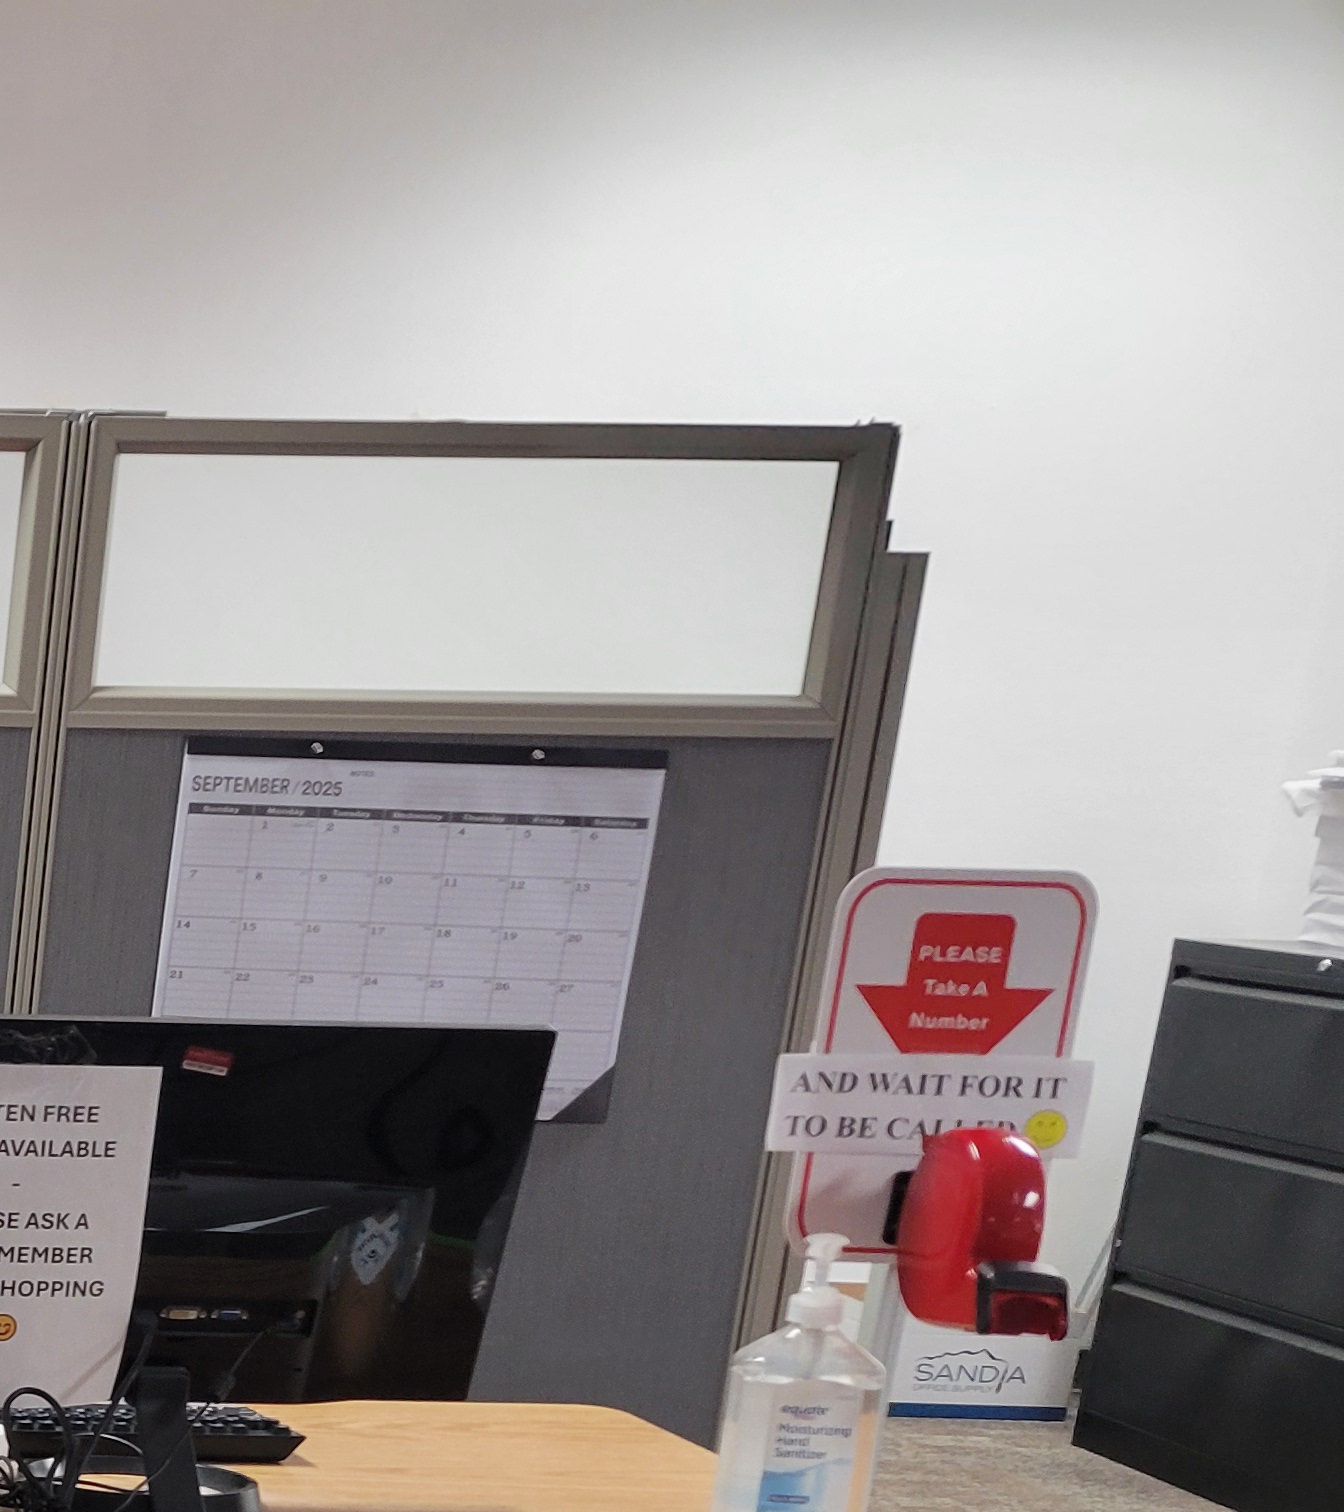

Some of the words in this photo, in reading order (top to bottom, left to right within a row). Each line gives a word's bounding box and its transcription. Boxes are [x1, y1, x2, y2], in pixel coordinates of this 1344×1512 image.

[192, 776, 291, 794] SEPTEMBER
[302, 781, 343, 796] 2025
[324, 823, 334, 832] 2
[378, 876, 393, 885] 10
[444, 879, 457, 887] 11
[511, 881, 525, 890] 12
[176, 920, 190, 929] 14
[242, 923, 256, 931] 15
[307, 925, 320, 933] 16
[371, 927, 385, 936] 17
[436, 929, 451, 938] 18
[503, 932, 517, 940] 19
[567, 934, 582, 943] 20
[919, 946, 1003, 964] PLEASE
[170, 971, 183, 979] 21
[236, 973, 250, 982] 22
[364, 978, 378, 986] 24
[924, 979, 969, 996] Take
[973, 981, 989, 996] A
[908, 1013, 990, 1031] Number
[790, 1071, 858, 1093] AND
[869, 1072, 952, 1096] WAIT
[959, 1074, 1024, 1098] FOR
[1032, 1076, 1068, 1099] IT
[43, 1105, 100, 1123] FREE
[784, 1114, 828, 1137] TO
[835, 1116, 878, 1139] BE
[24, 1213, 70, 1229] ASK
[74, 1214, 89, 1229] A
